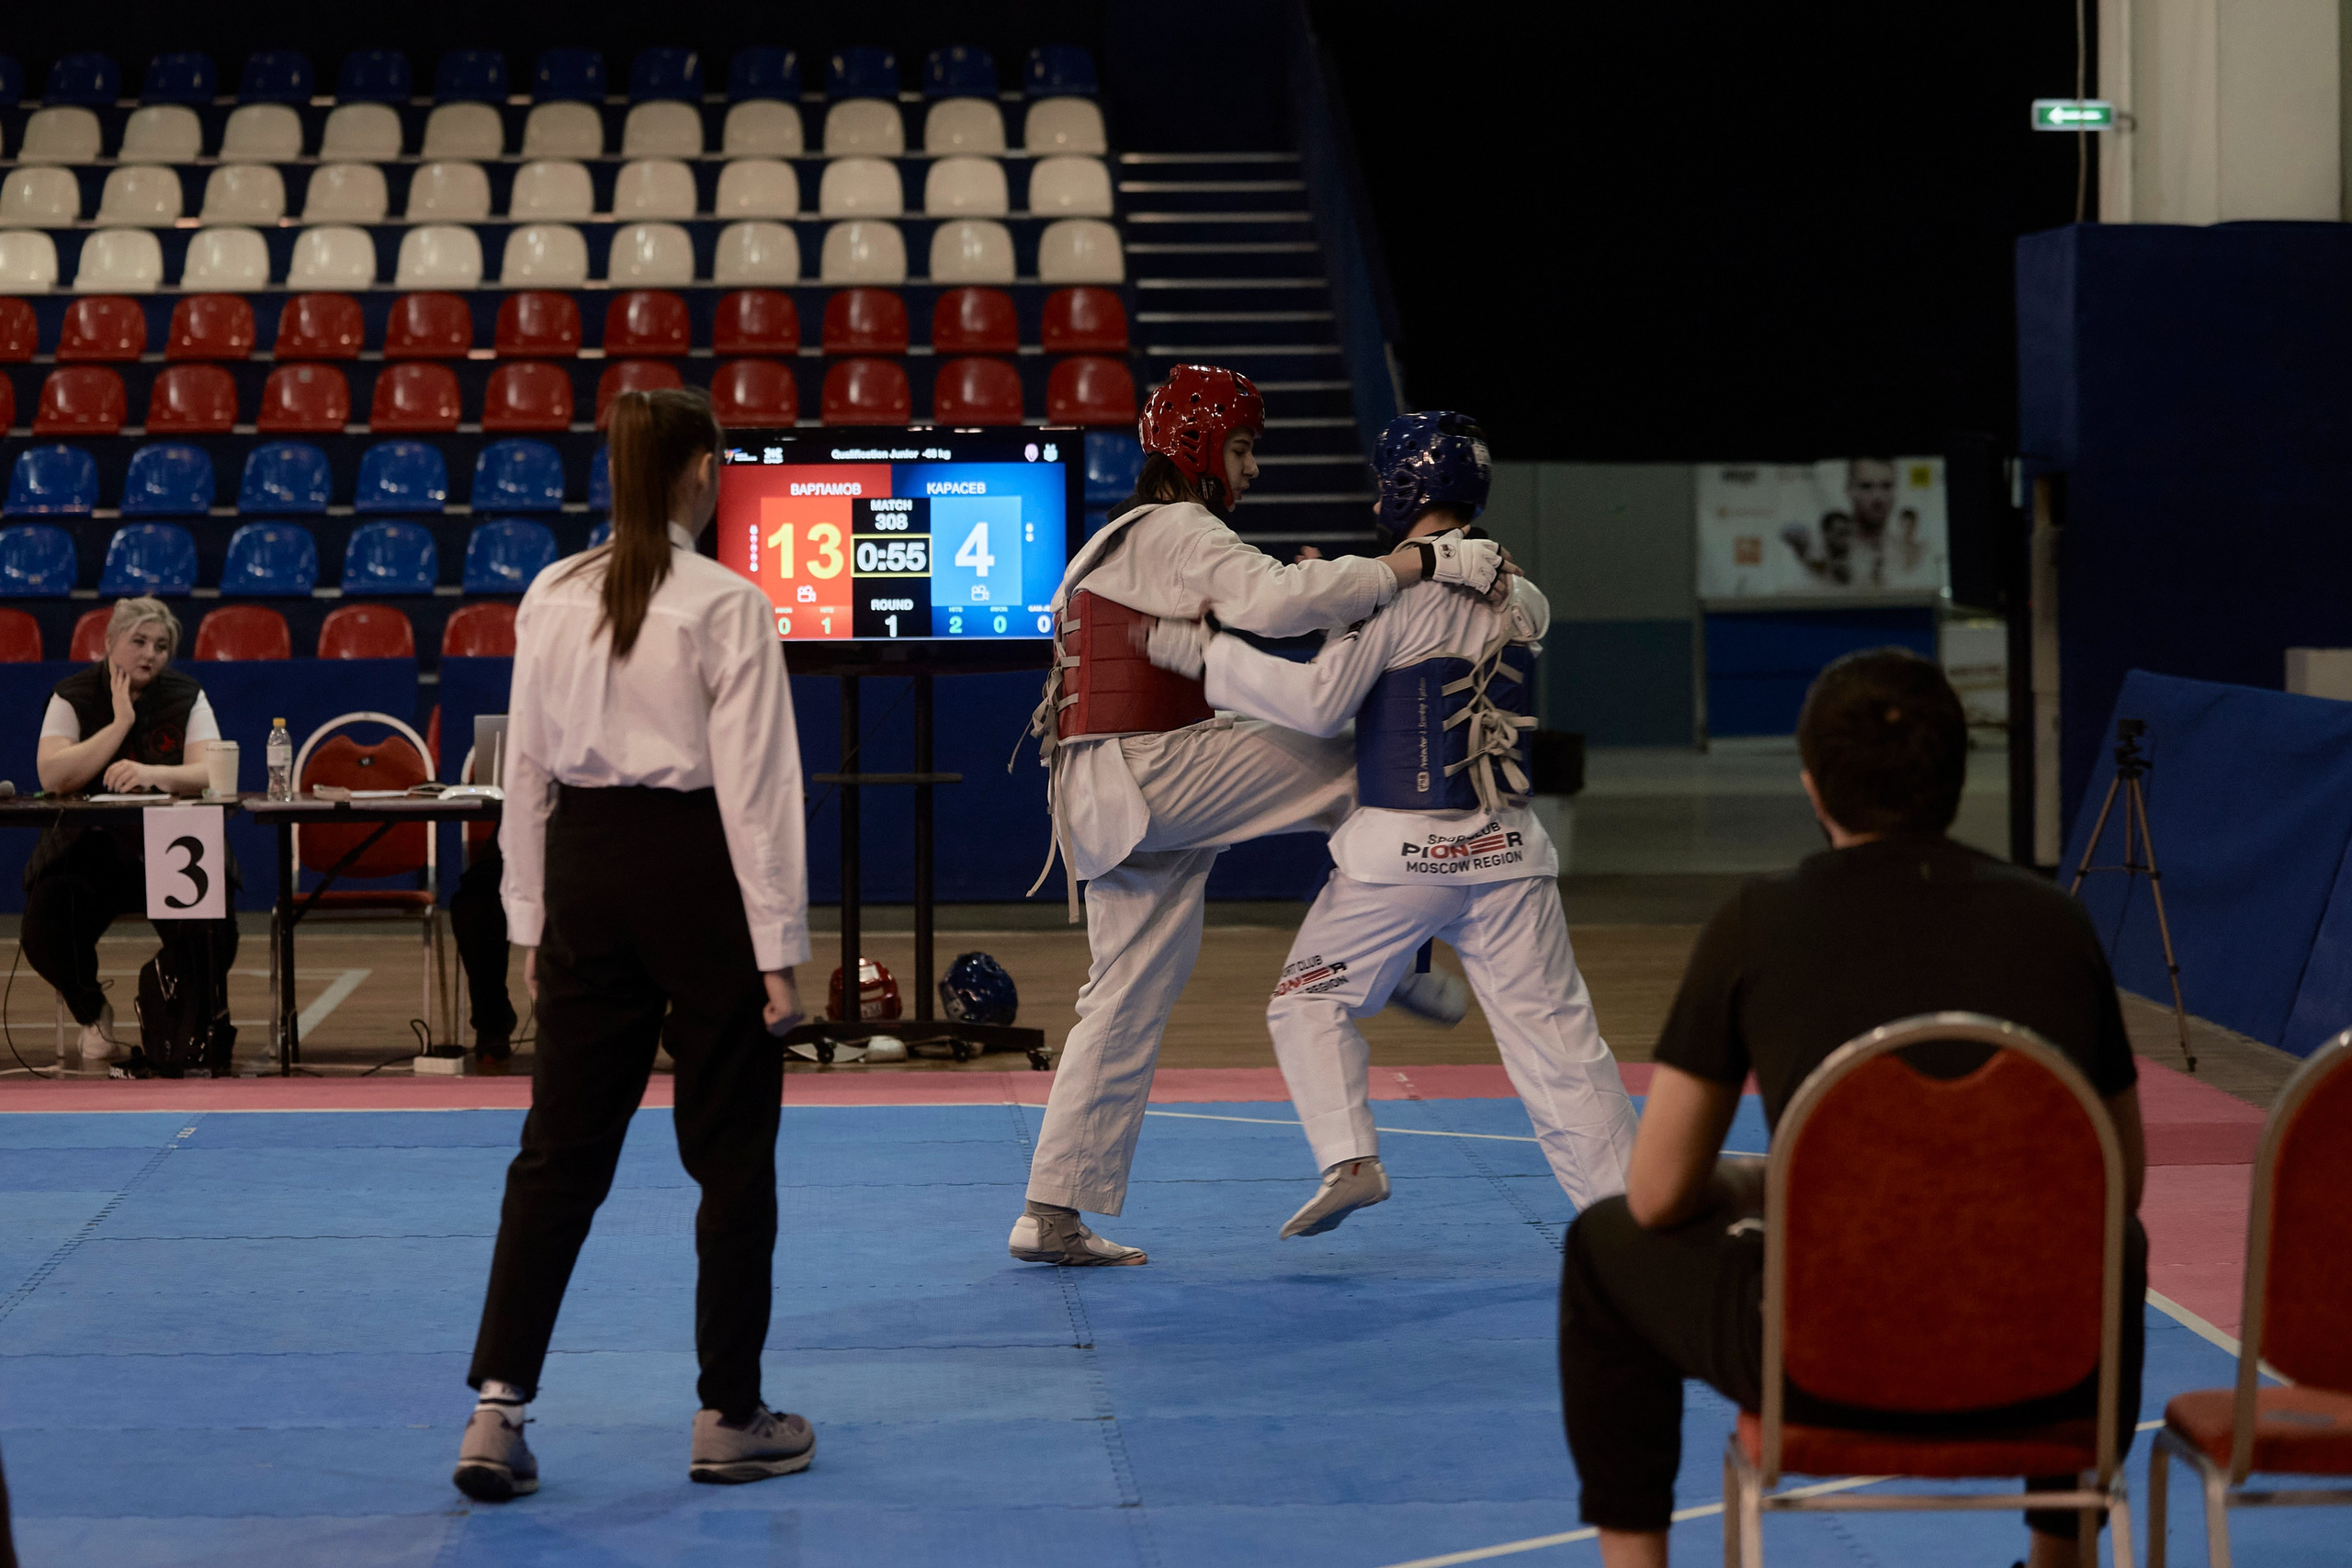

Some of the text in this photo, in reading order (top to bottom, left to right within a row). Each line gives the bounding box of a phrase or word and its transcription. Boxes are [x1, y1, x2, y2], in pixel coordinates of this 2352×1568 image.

[831, 448, 888, 459] Qualification
[888, 448, 919, 459] Junior
[938, 448, 952, 460] kg
[790, 482, 862, 496] ВАРЛАМОВ
[926, 481, 987, 495] КАРАСЕВ
[870, 499, 913, 512] MATCH
[875, 513, 909, 531] 308
[767, 522, 844, 580] 13
[856, 542, 927, 571] 0:55
[955, 522, 995, 577] 4
[871, 599, 914, 612] ROUND
[777, 616, 791, 635] 0
[820, 617, 831, 634] 1
[885, 615, 898, 637] 1
[949, 615, 963, 634] 2
[993, 615, 1007, 634] 0
[1037, 615, 1051, 634] 0
[1406, 850, 1524, 874] MOSCOW REGION
[164, 835, 209, 909] 3
